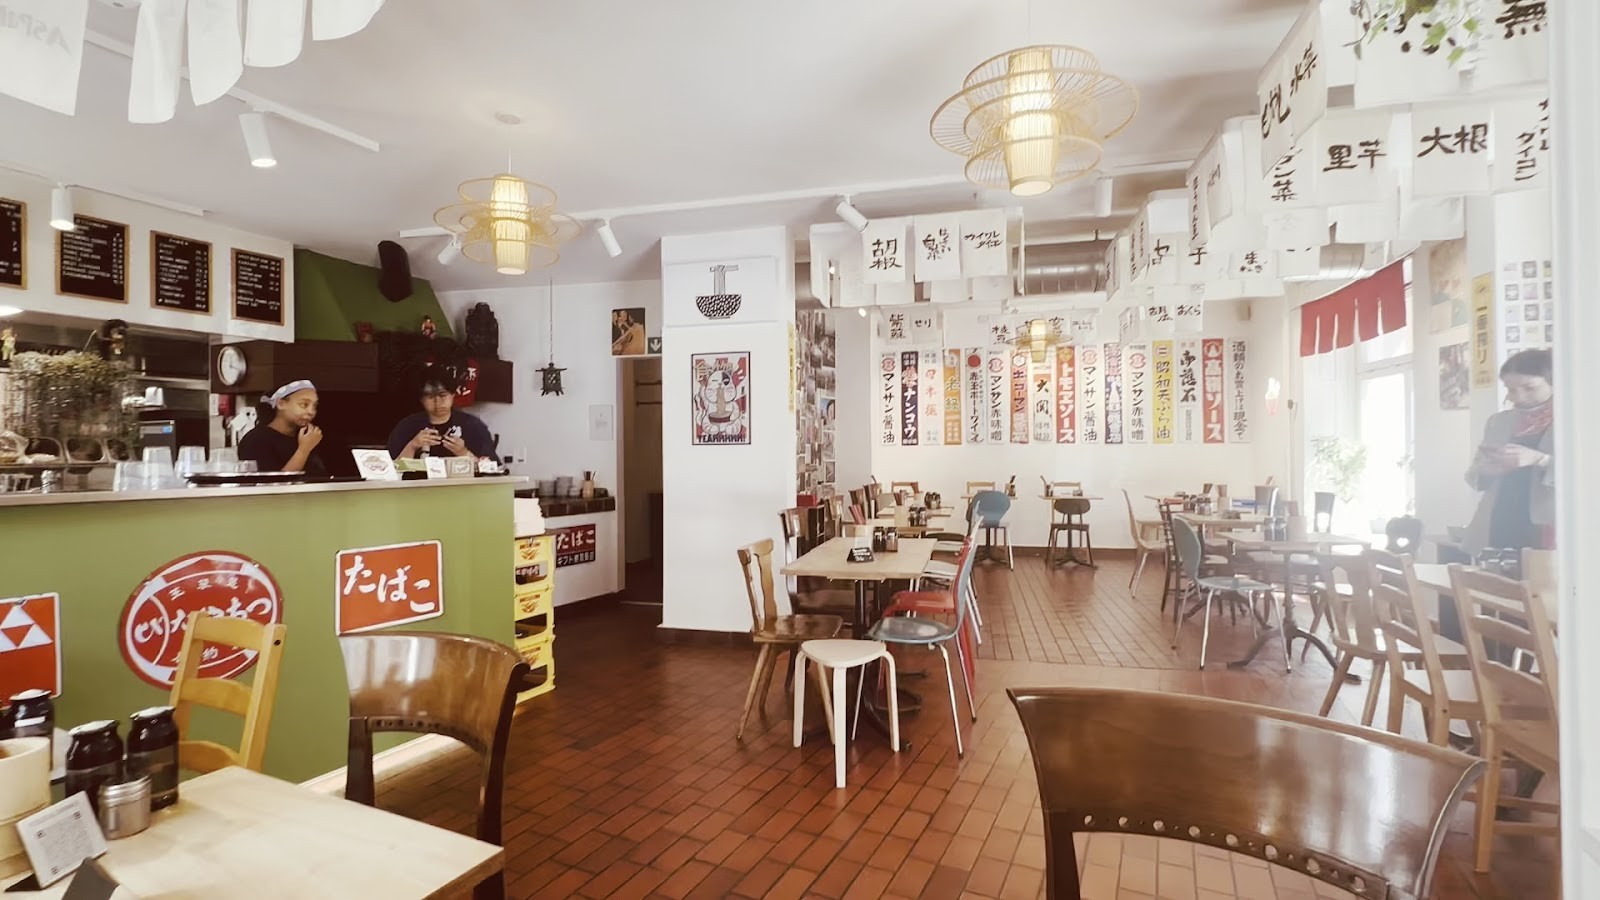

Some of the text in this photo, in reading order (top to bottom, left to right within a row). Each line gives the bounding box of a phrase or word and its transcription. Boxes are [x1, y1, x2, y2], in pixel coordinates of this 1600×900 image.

[1323, 138, 1387, 172] 里芋
[1417, 123, 1488, 158] 大根
[870, 237, 902, 270] 胡椒
[557, 529, 596, 549] たばこ
[342, 554, 435, 613] たばこ
